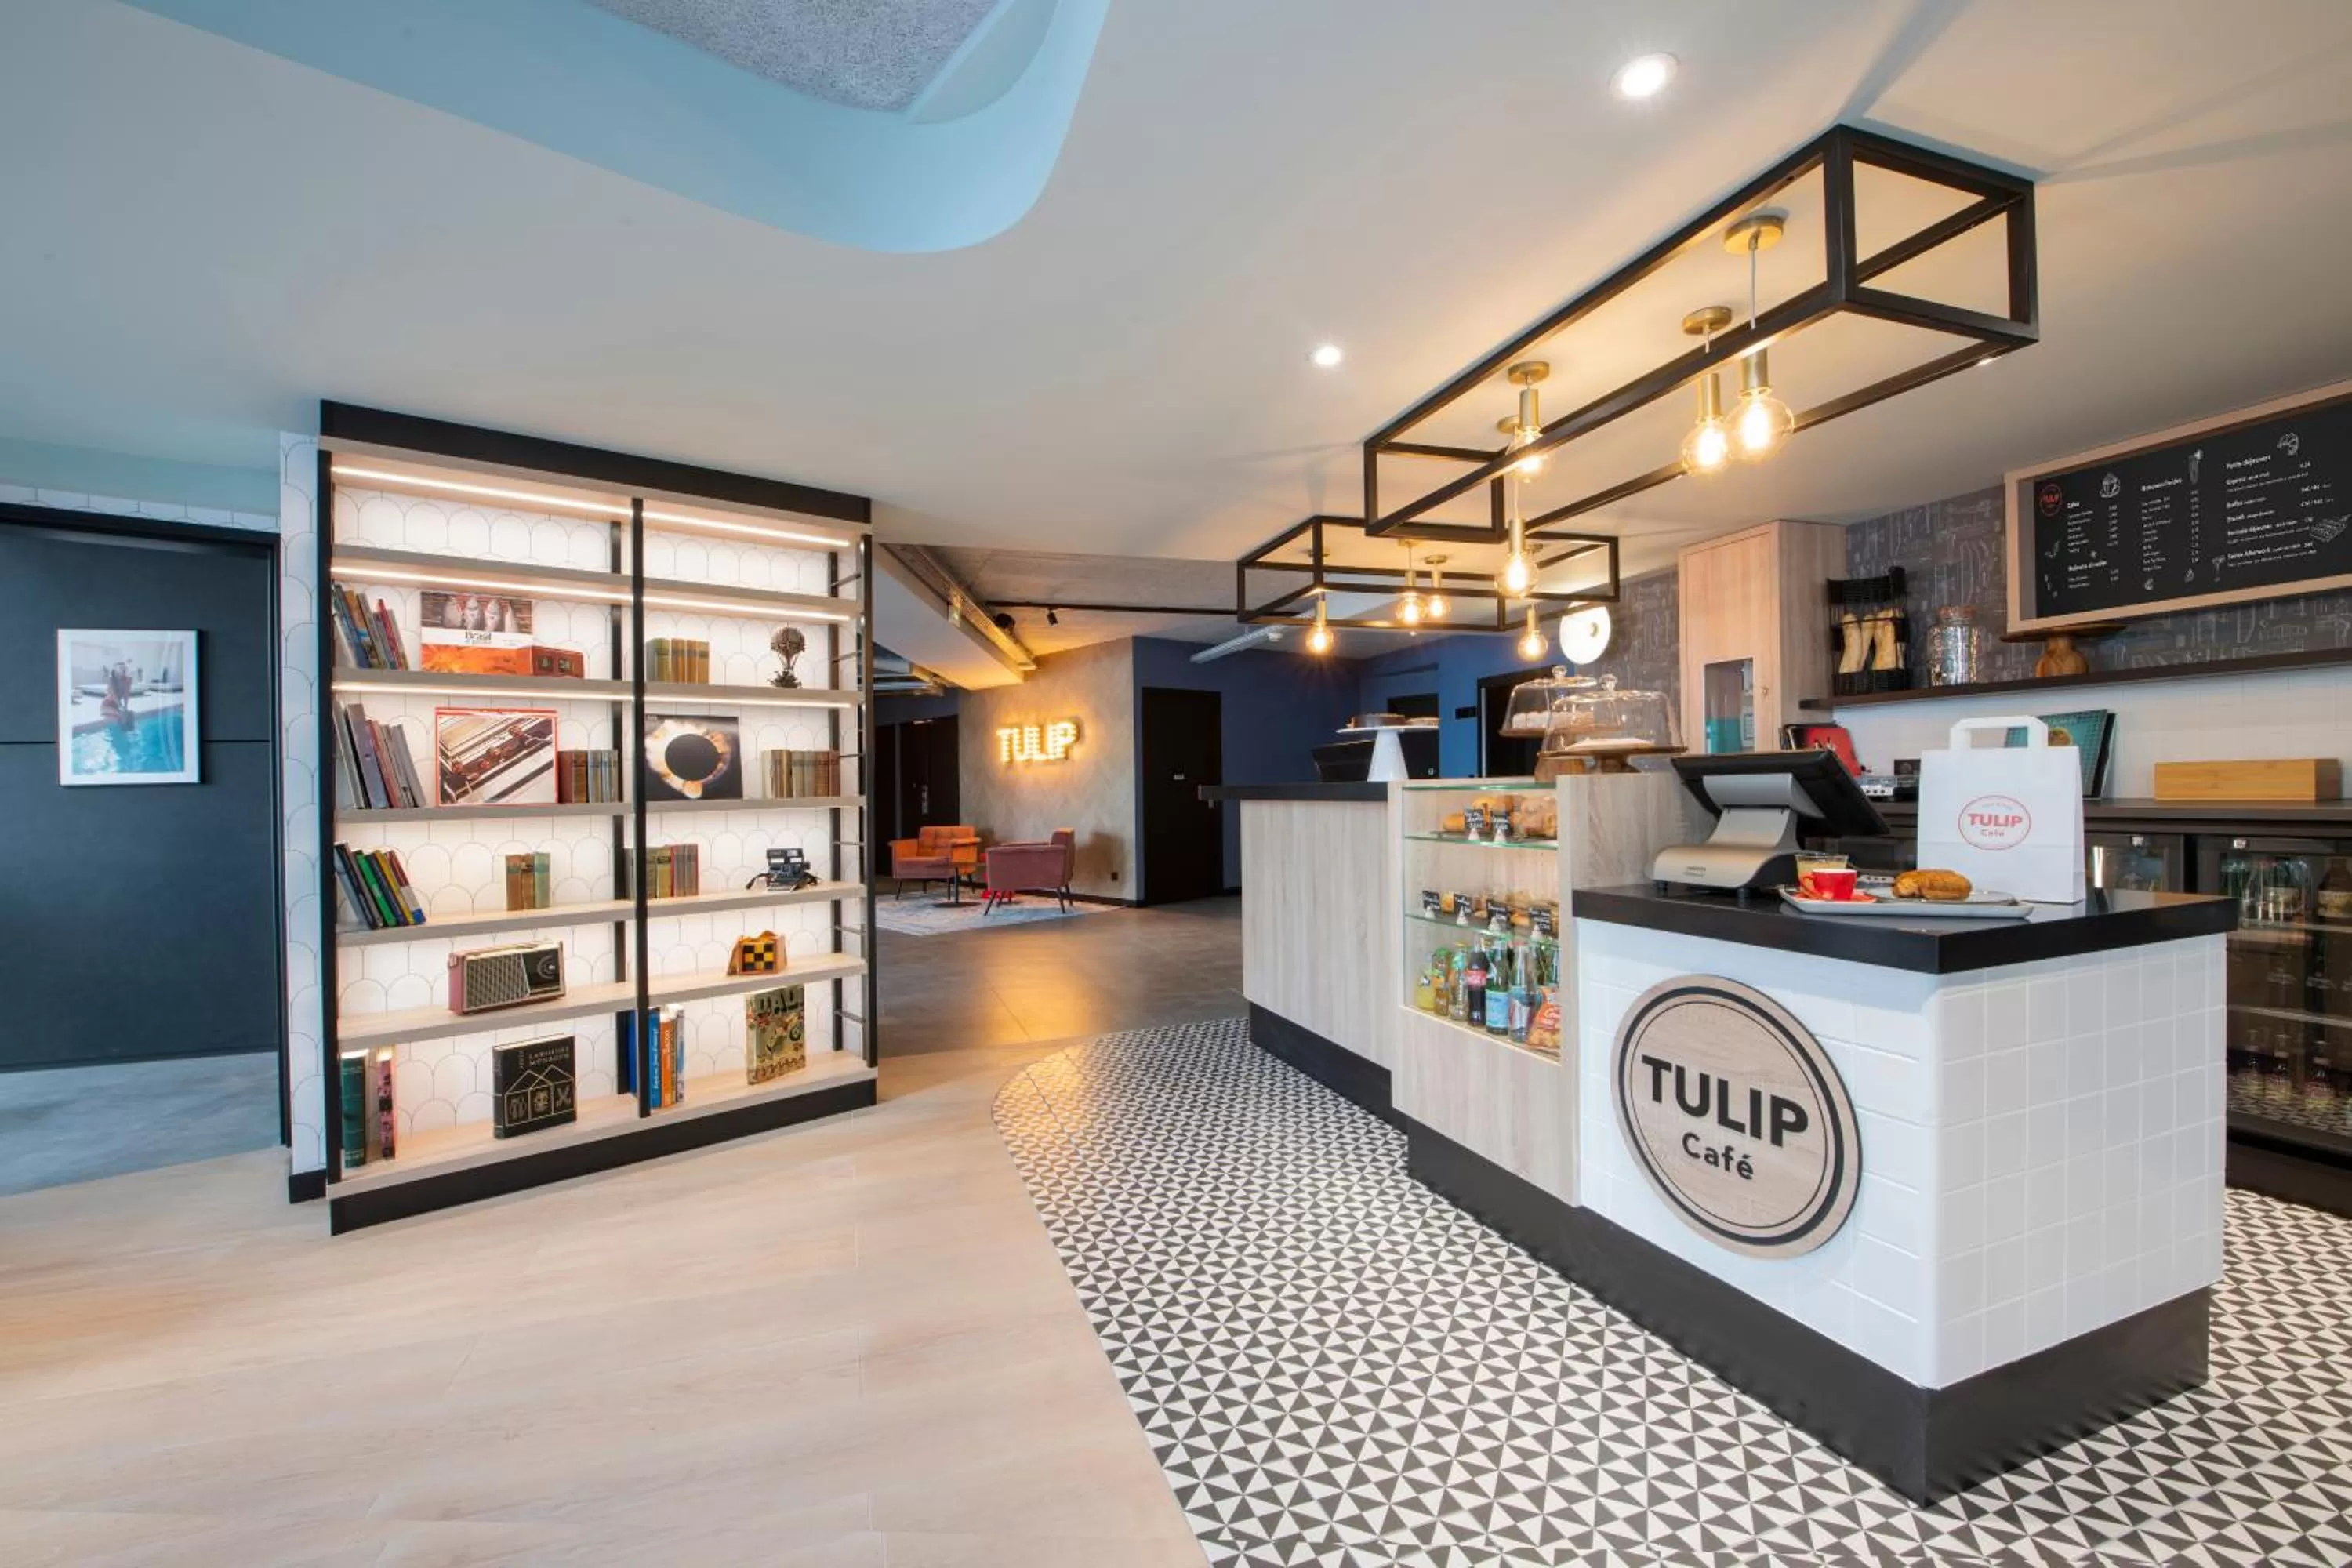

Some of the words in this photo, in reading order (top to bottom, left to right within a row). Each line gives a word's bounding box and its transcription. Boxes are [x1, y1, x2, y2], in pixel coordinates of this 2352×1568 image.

[996, 720, 1080, 764] TULIP
[1967, 813, 2023, 828] TULIP
[1641, 1054, 1809, 1148] TULIP
[1682, 1132, 1755, 1180] Café
